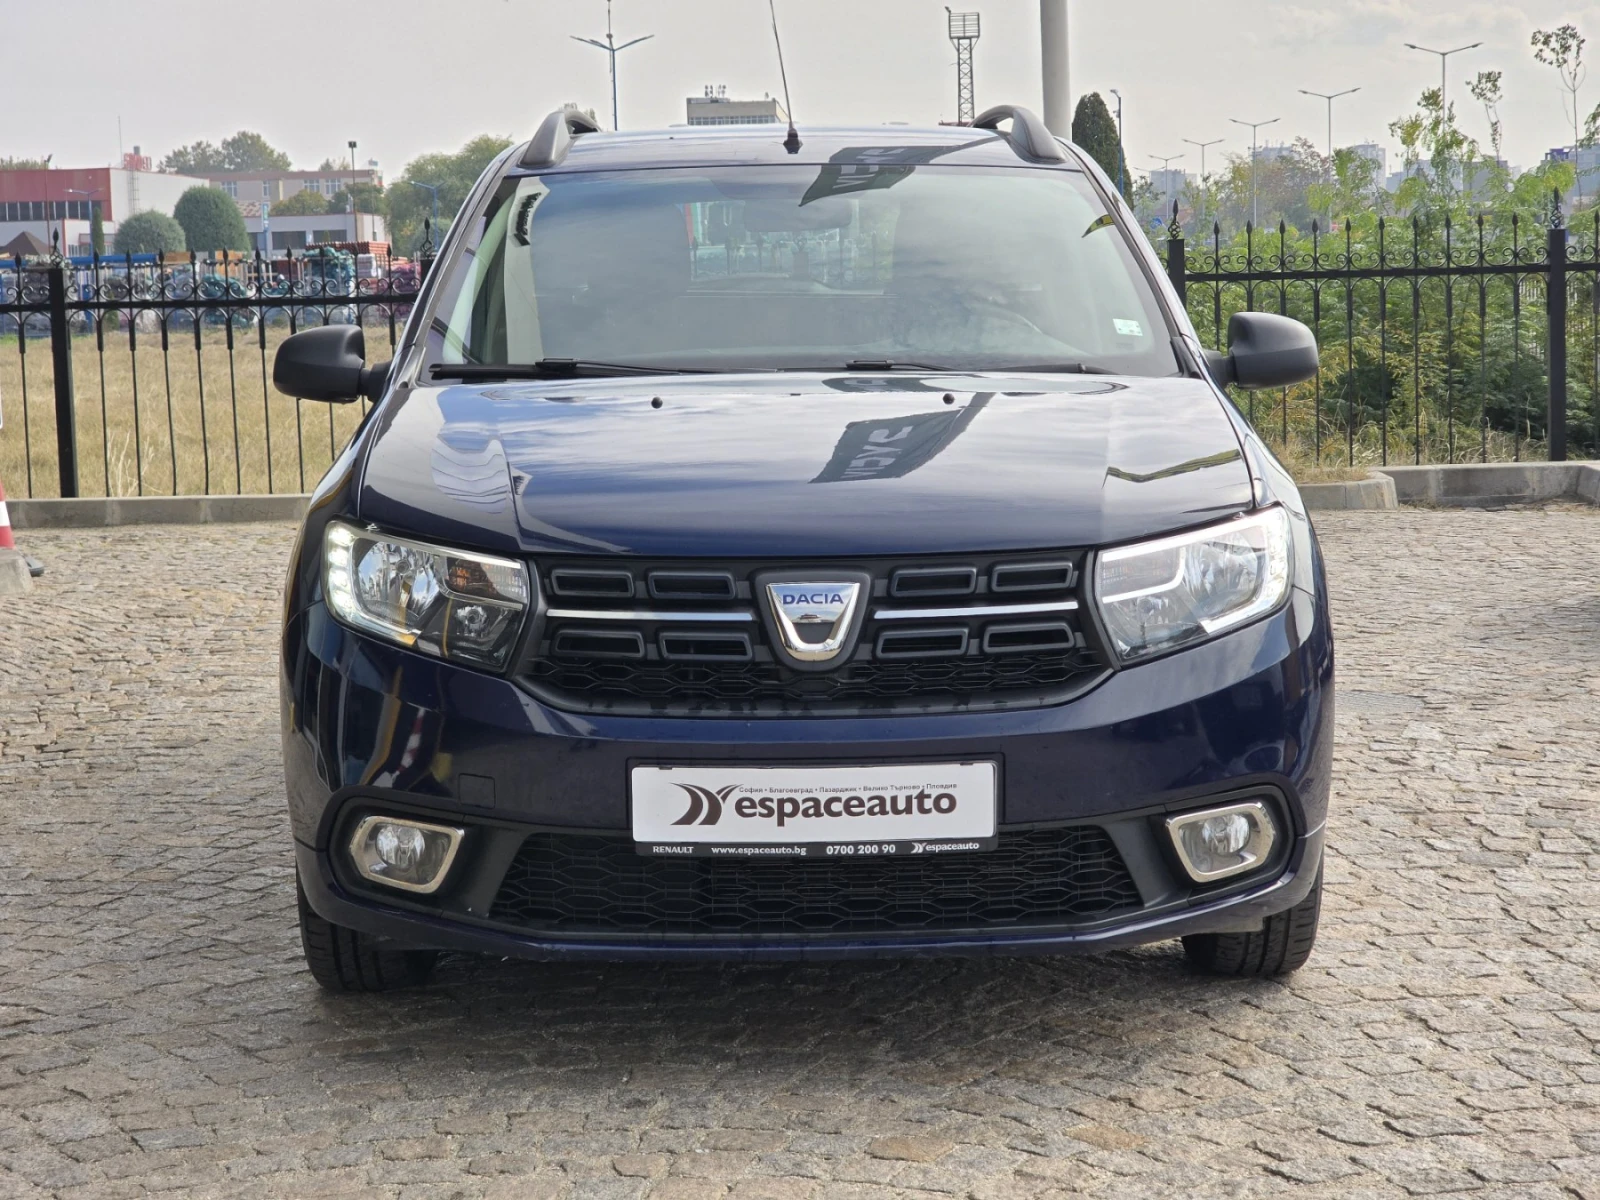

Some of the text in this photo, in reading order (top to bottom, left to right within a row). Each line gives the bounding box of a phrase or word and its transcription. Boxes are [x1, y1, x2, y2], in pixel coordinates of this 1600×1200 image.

[782, 593, 844, 605] DACIA
[739, 786, 763, 794] София
[769, 786, 813, 795] Благоевград
[890, 784, 920, 792] Търново
[926, 782, 957, 790] Пловдив
[734, 788, 957, 827] espaceauto
[652, 846, 694, 854] RENAULT
[711, 845, 807, 856] www.espaceauto.bg
[826, 843, 896, 855] 0700 200 90
[925, 842, 980, 852] espaceauto
